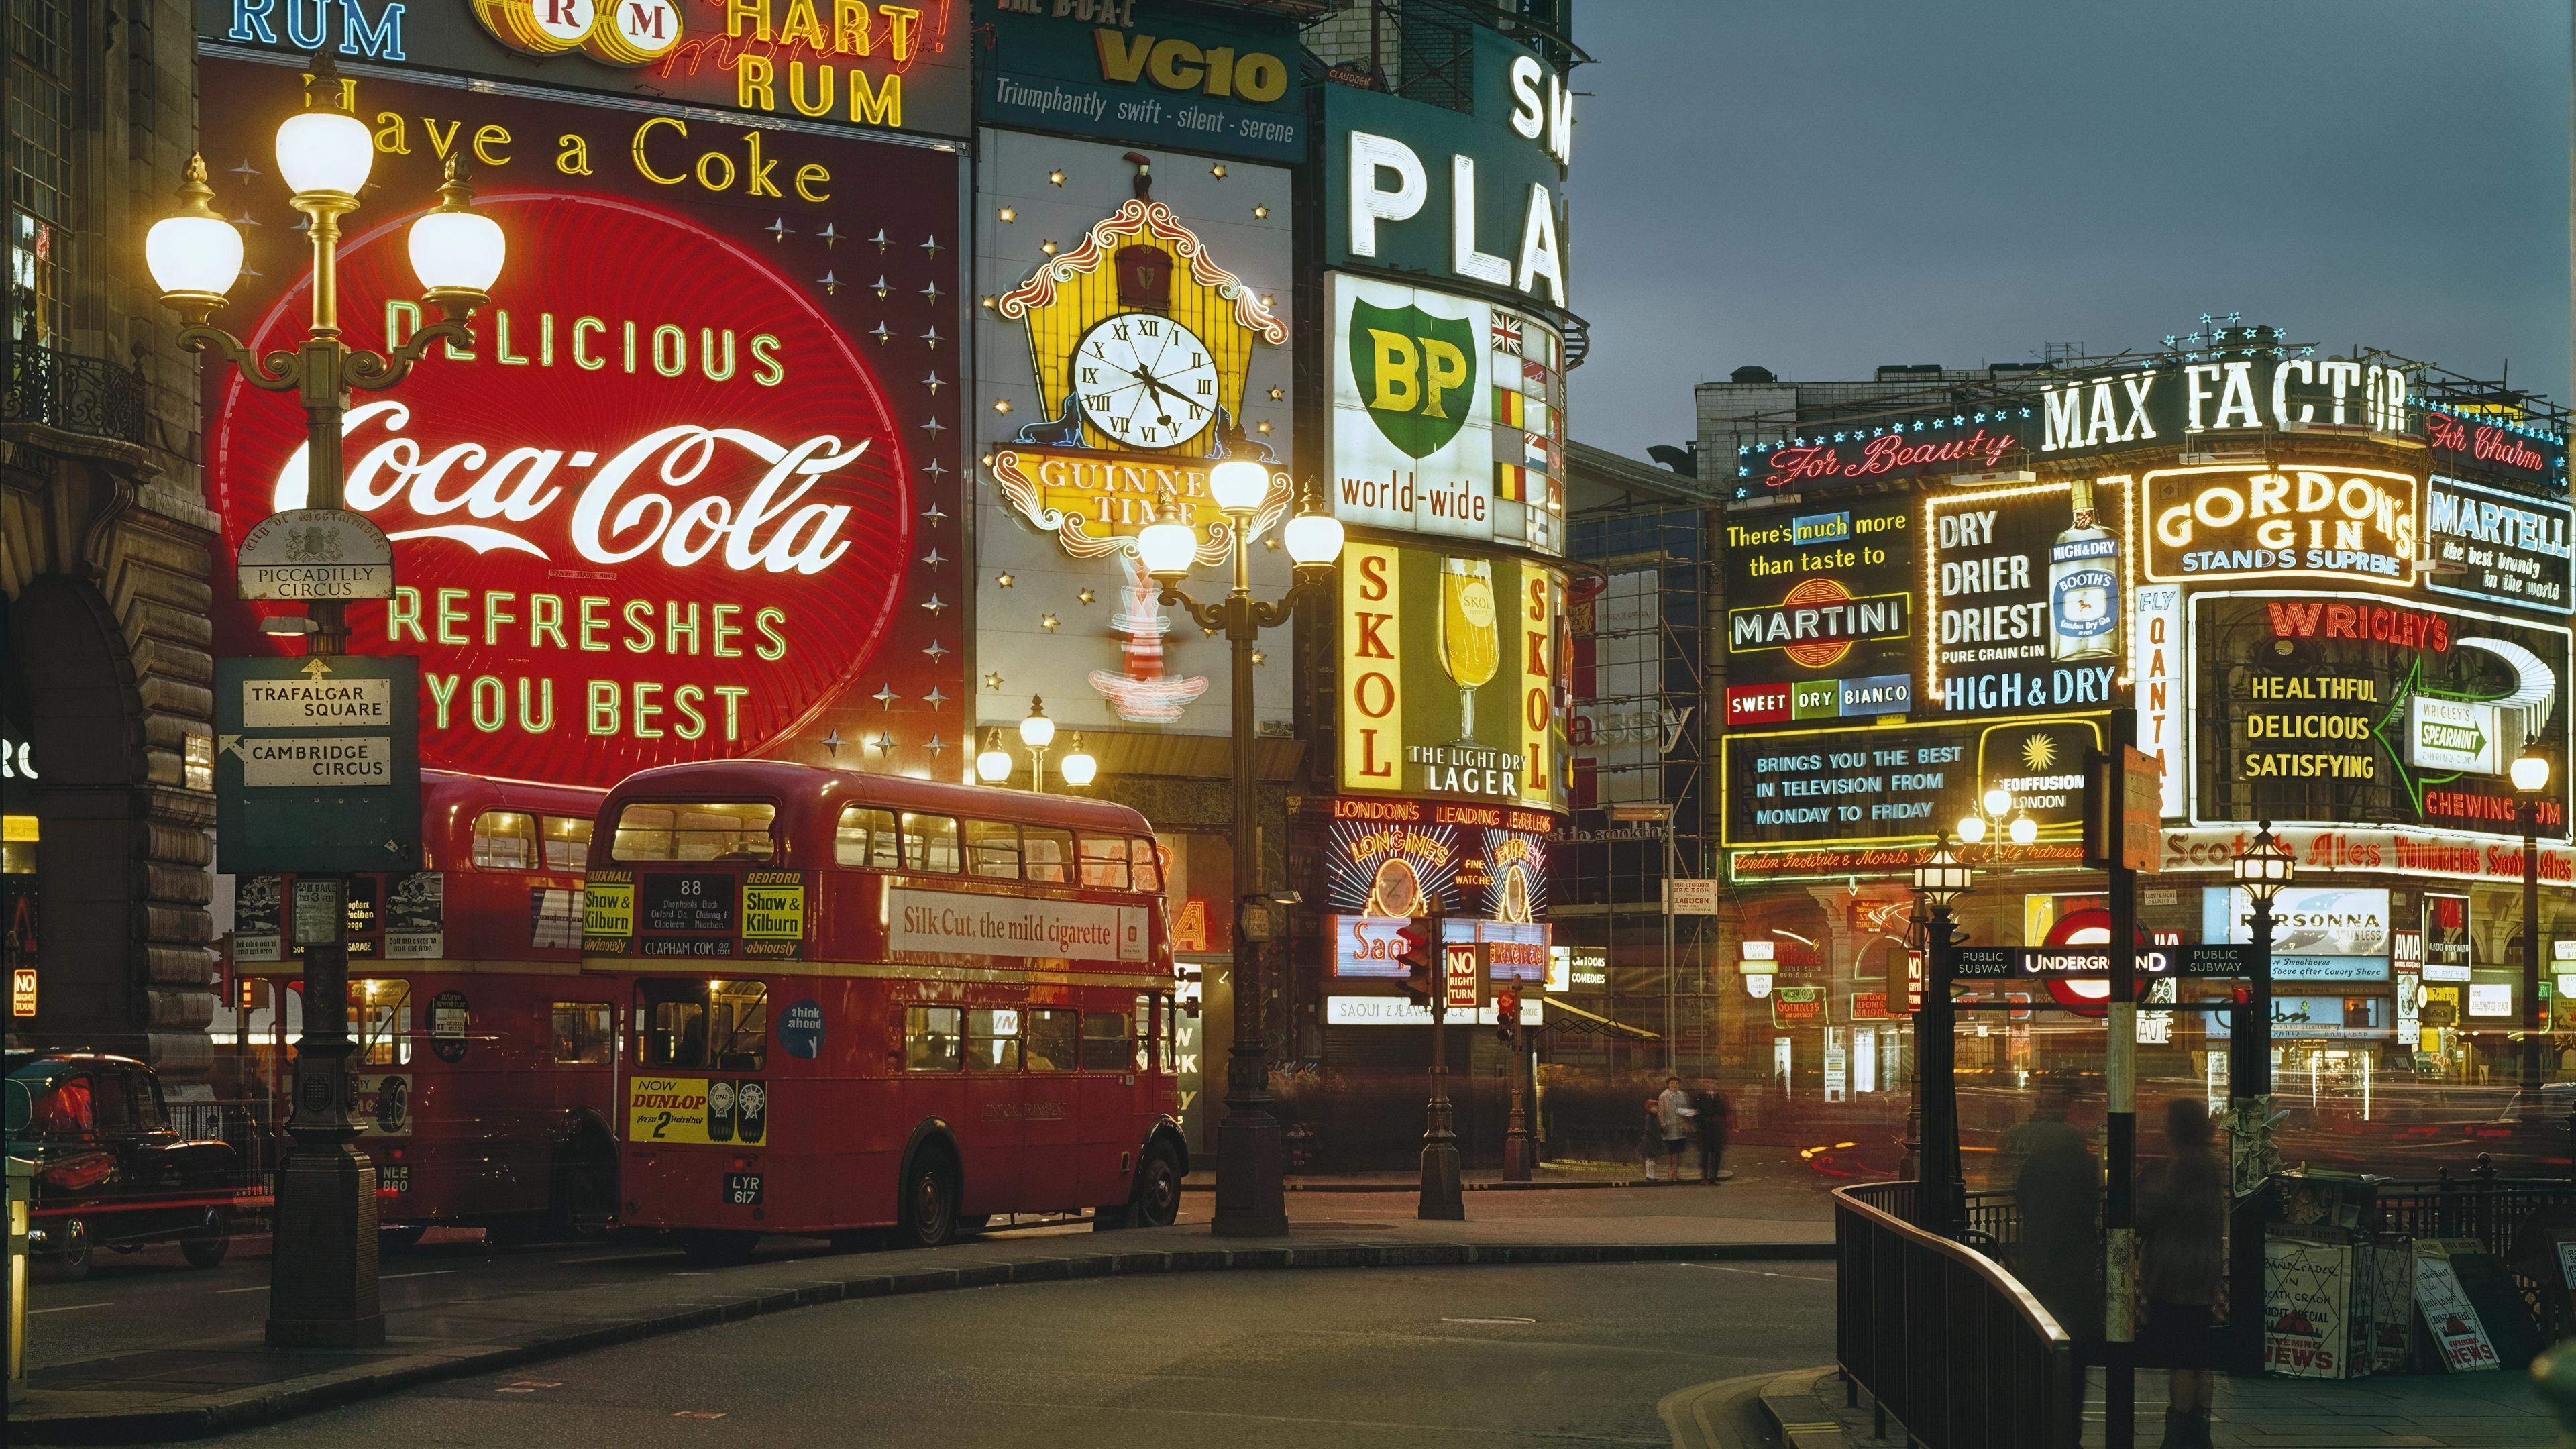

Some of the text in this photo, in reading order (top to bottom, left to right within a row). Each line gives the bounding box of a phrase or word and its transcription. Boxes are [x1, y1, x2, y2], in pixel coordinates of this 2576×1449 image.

[229, 0, 406, 61] RUM
[545, 0, 666, 39] R M
[727, 0, 919, 61] HART
[1093, 28, 1287, 103] VC10
[738, 54, 902, 127] RUM
[997, 78, 1294, 143] Triumphantly swift silent serene
[556, 133, 594, 176] a
[631, 117, 830, 203] Coke
[1367, 328, 1467, 419] BP
[2040, 360, 2408, 451] MAX FACTOR
[2426, 411, 2543, 470] For Charm
[1766, 429, 2015, 488] For Beauty
[274, 400, 873, 574] Coca-Cola
[1040, 460, 1206, 498] GUINNE
[1341, 470, 1486, 522] world-wide
[1939, 510, 1999, 549] DRY
[2157, 472, 2413, 561] GORDON'S
[2430, 490, 2571, 559] MARTELL
[1727, 515, 1907, 548] There's much more
[2256, 519, 2365, 550] GIN
[1750, 547, 1886, 577] than taste to
[2182, 549, 2297, 572] STANDS
[2467, 545, 2493, 566] best
[259, 568, 374, 582] PICCADILLY
[1941, 555, 2031, 596] DRIER
[2059, 572, 2112, 593] BOOTH'S
[2483, 570, 2560, 600] in the world
[279, 582, 352, 596] CIRCUS
[2139, 591, 2176, 612] FLY
[1464, 596, 1492, 609] SKOL
[387, 586, 787, 661] REFRESHES
[1734, 601, 1899, 645] MARTINI
[1941, 602, 2047, 645] DRIEST
[2267, 602, 2449, 653] WRIGLEY'S
[1354, 556, 1395, 777] SKOL
[1941, 644, 2046, 663] PURE GRAIN GIN
[252, 687, 364, 701] TRAFALGAR
[1527, 578, 1549, 790] SKOL
[1945, 665, 2115, 711] HIGH & DRY
[2252, 676, 2377, 703] HEALTHFUL
[304, 703, 382, 717] SQUARE
[425, 672, 750, 741] YOU BEST
[1732, 694, 1786, 713] SWEET
[1844, 685, 1909, 705] BIANCO
[2149, 616, 2167, 790] QANTA
[2247, 714, 2371, 741] DELICIOUS
[2422, 725, 2479, 751] SPEARMINT
[252, 745, 368, 760] CAMBRIDGE
[1411, 746, 1527, 771] THE LIGHT DRY
[1756, 746, 1964, 773] BRINGS YOU THE BEST
[313, 762, 383, 775] CIRCUS
[2245, 753, 2374, 780] SATISFYING
[1429, 765, 1518, 796] LAGER
[1756, 772, 1945, 798] IN TELEVISION FROM
[1998, 775, 2085, 792] EDIFFUSION
[1334, 800, 1500, 826] LONDON'S LEADING
[1756, 802, 1934, 826] MONDAY TO FRIDAY
[2012, 794, 2067, 809] LONDON
[2426, 790, 2561, 826] CHEWING UM
[1349, 830, 1449, 867] LONGINES
[2167, 833, 2381, 869] Scot Ales
[1466, 859, 1484, 869] FINE
[681, 880, 702, 895] 88
[747, 872, 800, 884] BEDFORD
[1455, 875, 1496, 885] WATCHES
[585, 890, 631, 909] Shaw &
[747, 892, 800, 910] Shaw &
[584, 910, 629, 930] Kilburn
[747, 913, 798, 932] Kilburn
[904, 906, 941, 935] Silk
[980, 911, 1005, 939] the
[1008, 914, 1044, 942] mild
[1048, 916, 1111, 953] cigarette
[2241, 914, 2381, 928] PRSONNA
[645, 942, 690, 955] CLAPHAM
[694, 942, 715, 955] COM
[746, 941, 797, 957] obviously
[1962, 951, 2004, 962] PUBLIC
[2194, 950, 2238, 961] PUBLIC
[2394, 934, 2421, 960] AVIA
[1450, 951, 1474, 974] NO
[1909, 956, 1921, 979] NO
[1958, 963, 2008, 974] SUBWAY
[2025, 953, 2167, 973] UNDERGRND
[2190, 961, 2242, 972] SUBWAY
[16, 974, 35, 992] NO
[1450, 977, 1474, 986] RIGHT
[1450, 989, 1474, 1000] TURN
[637, 1081, 677, 1091] NOW
[632, 1094, 707, 1110] DUNLOP
[653, 1111, 672, 1138] 2
[733, 1177, 760, 1191] LYR
[735, 1191, 756, 1204] 617
[2447, 1343, 2495, 1365] NEWS
